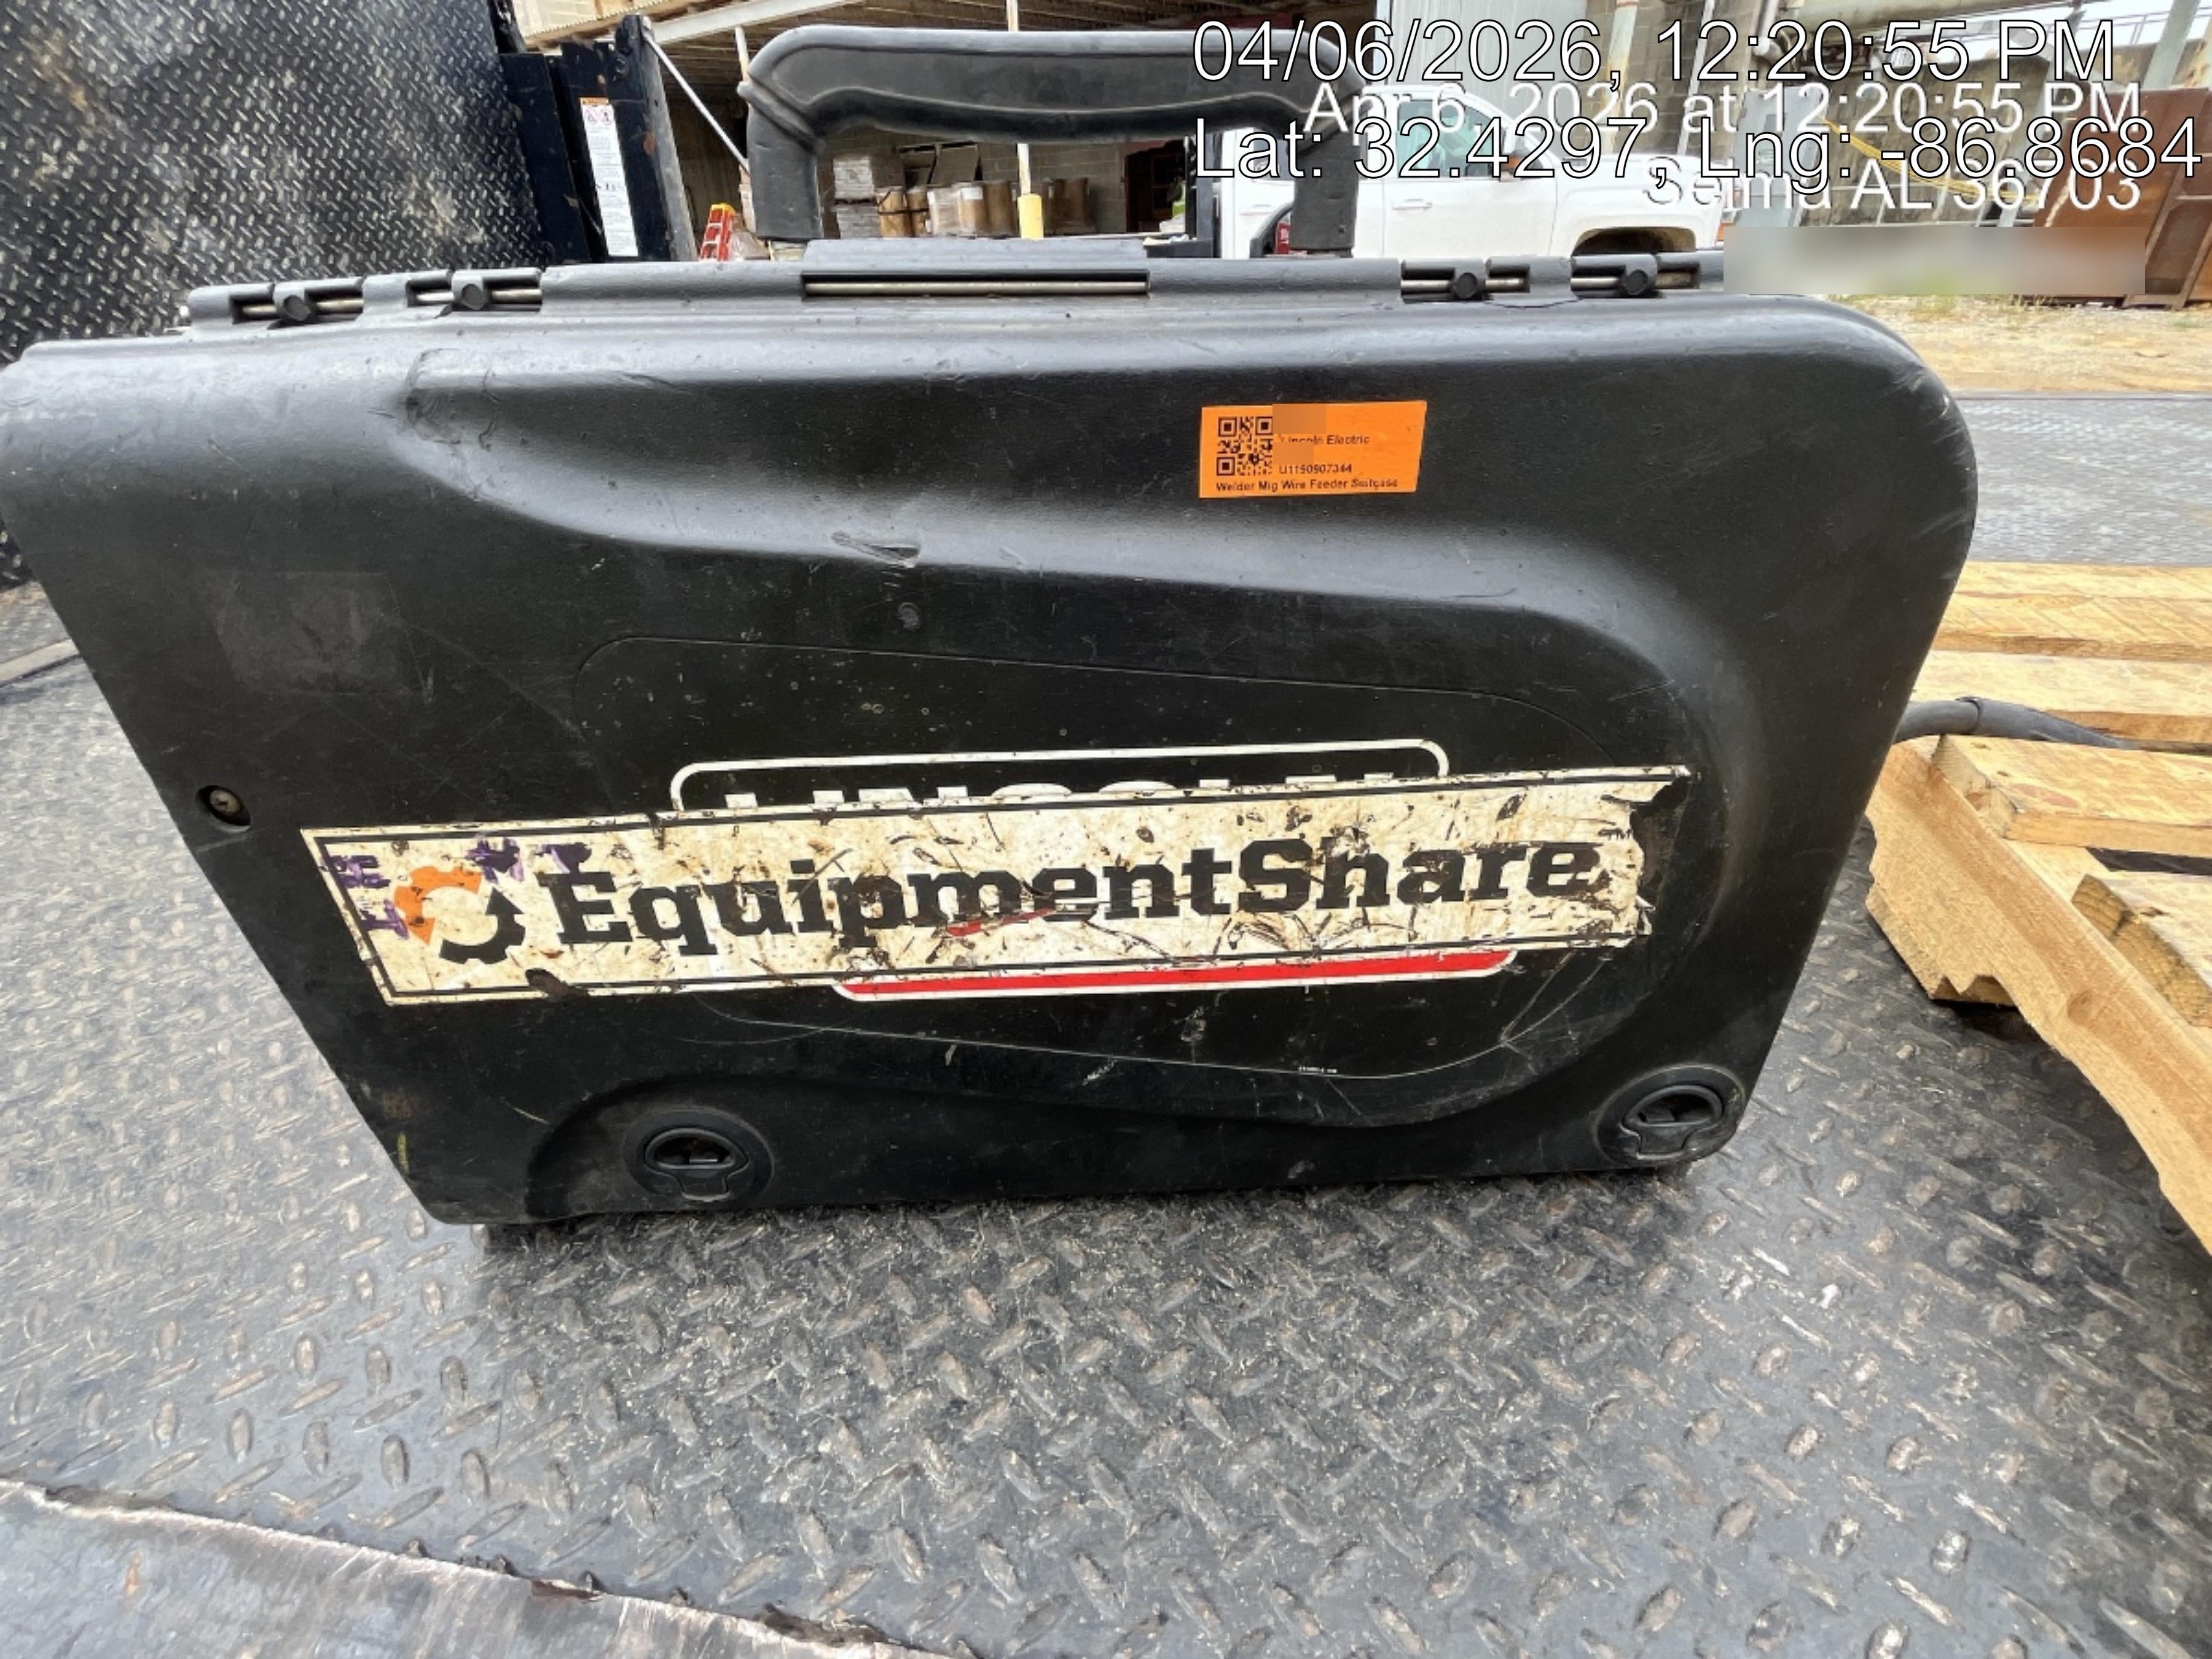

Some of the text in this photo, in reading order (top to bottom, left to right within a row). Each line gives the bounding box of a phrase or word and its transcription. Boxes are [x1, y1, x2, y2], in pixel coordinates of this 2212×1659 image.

[1327, 434, 1370, 445] Electric
[1216, 481, 1254, 492] Welder
[1258, 480, 1279, 492] Mig
[1281, 480, 1306, 490] Wire
[1310, 479, 1348, 489] Feeder
[537, 836, 1604, 957] EquipmentShare
